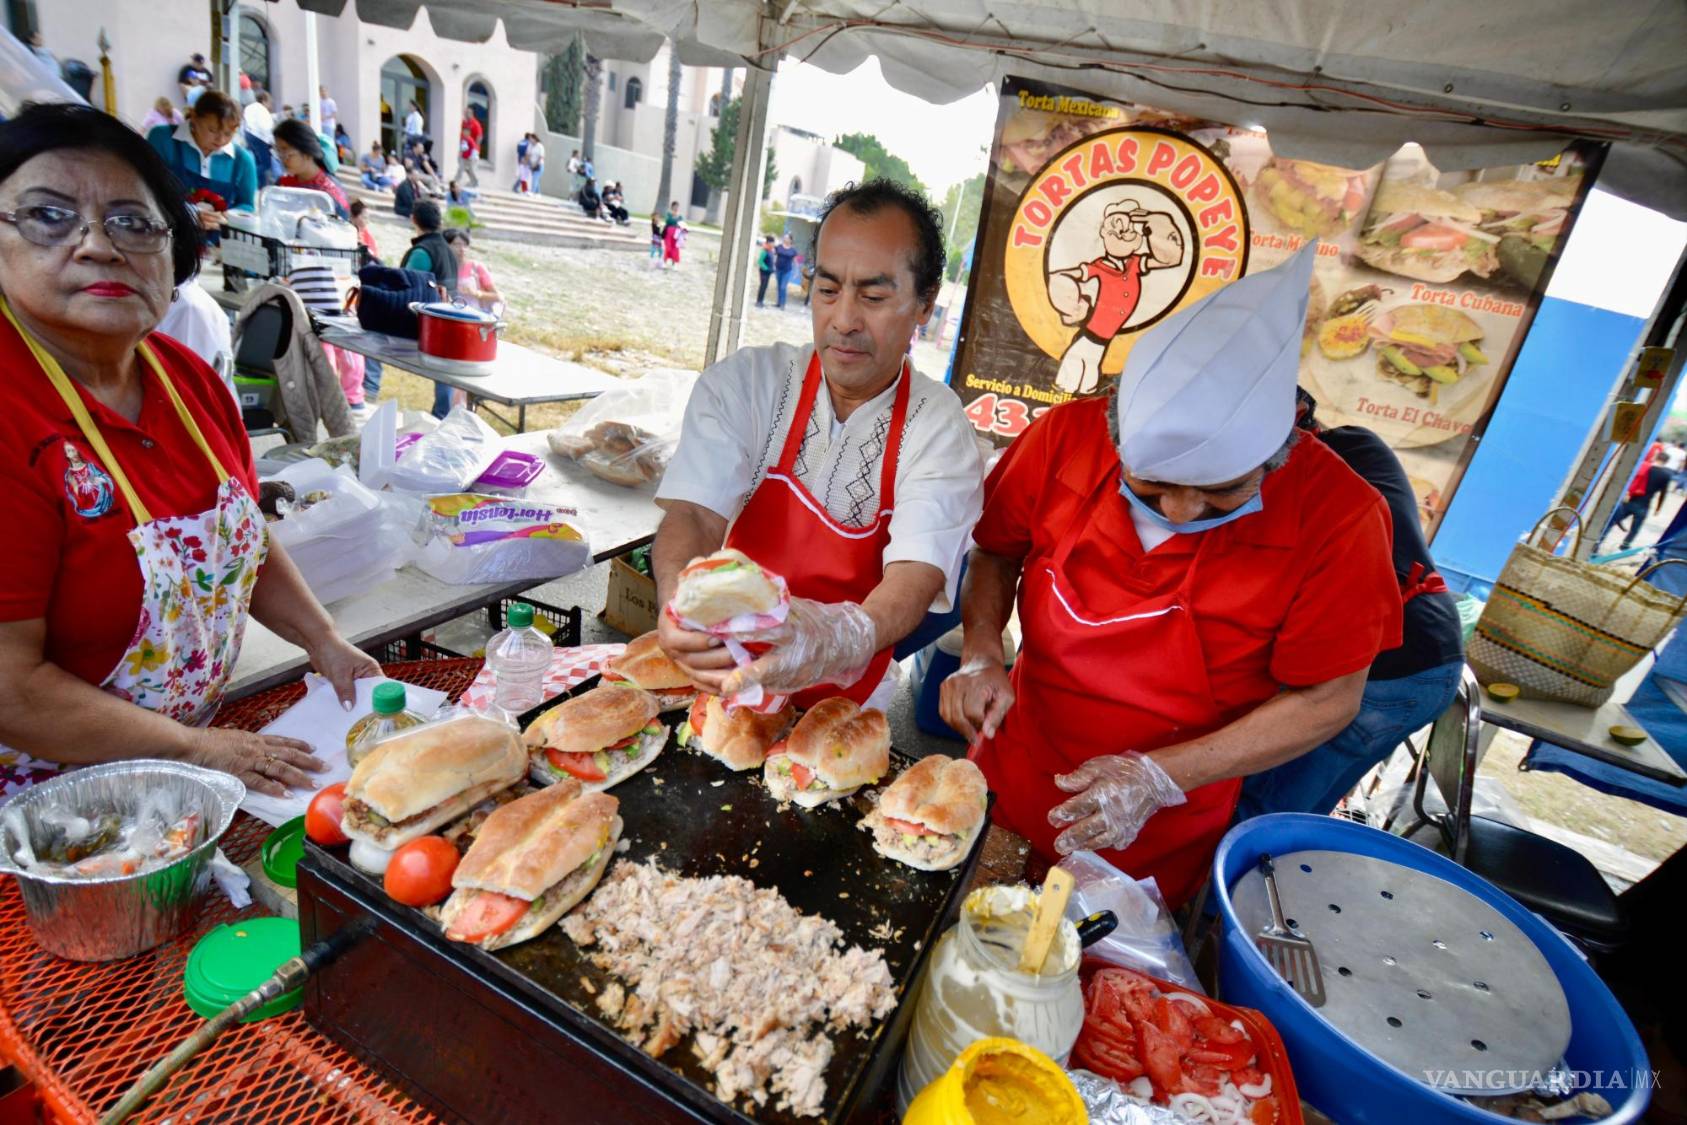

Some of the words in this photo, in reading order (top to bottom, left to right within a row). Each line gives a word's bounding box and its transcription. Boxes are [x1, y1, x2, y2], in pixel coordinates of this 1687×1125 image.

[1018, 89, 1055, 111] Torta
[1013, 137, 1139, 249] TORTAS
[1147, 139, 1239, 281] POPEYE
[1286, 234, 1339, 257] Mino
[1411, 283, 1456, 306] Torta
[1460, 291, 1525, 318] Cubana
[966, 373, 1012, 395] Servicio
[1013, 385, 1022, 396] a
[1356, 397, 1399, 419] Torta
[1401, 406, 1420, 424] El
